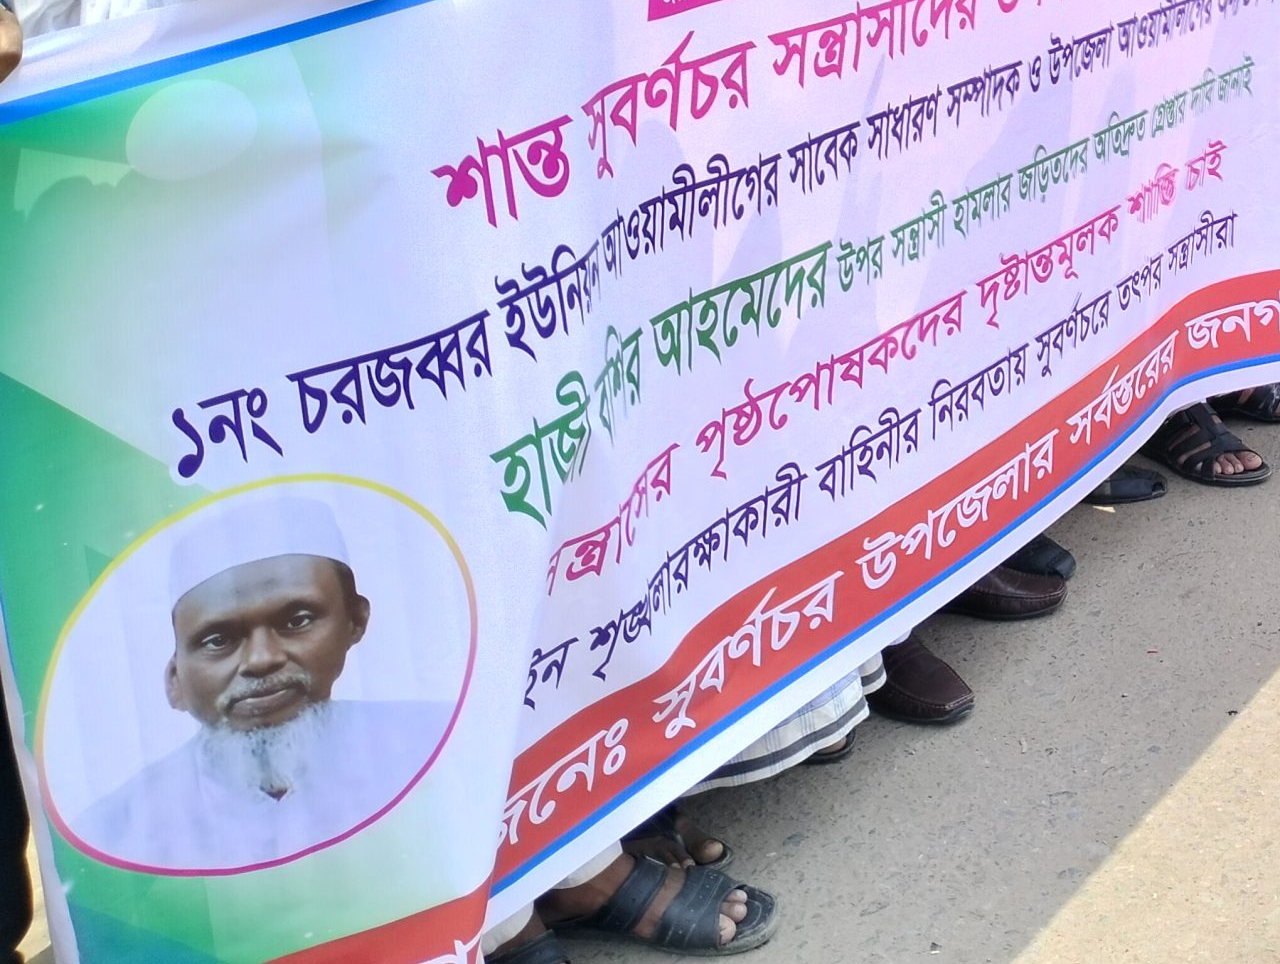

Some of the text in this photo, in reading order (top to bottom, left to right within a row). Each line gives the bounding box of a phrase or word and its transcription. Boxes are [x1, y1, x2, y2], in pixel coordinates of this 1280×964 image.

[172, 387, 283, 478] ১নং
[286, 310, 492, 434] চরজব্বর
[495, 244, 602, 363] ইউনিয়ন
[602, 153, 782, 276] আওয়ামীলীগের
[787, 121, 861, 194] সাবেক
[866, 85, 942, 161] সাধারণ
[947, 61, 1022, 127] সম্পাদক
[1029, 56, 1041, 92] ও
[1048, 21, 1114, 84] উপজেলা
[430, 115, 573, 227] শান্ত
[581, 31, 756, 179] সুবর্ণচর
[490, 371, 591, 531] হাজী
[650, 241, 833, 376] আহমেদের
[836, 235, 886, 293] উপর
[890, 189, 948, 267] সন্ত্রাসী
[952, 173, 1014, 238] হামলার
[1017, 138, 1090, 203] জড়িতদের
[1092, 111, 1149, 165] অতিদ্রুত
[1217, 52, 1255, 98] জানাই
[696, 291, 967, 479] পৃষ্ঠপোষকদের
[976, 205, 1121, 328] দৃষ্টান্তমূলক
[1126, 163, 1179, 223] শাস্তি
[1185, 139, 1227, 192] চাই
[652, 571, 844, 740] সুবর্ণচর
[855, 429, 1059, 589] উপজেলার
[1068, 330, 1180, 446] সর্বস্তরের
[815, 407, 921, 502] বাহিনীর
[928, 343, 1029, 440] নিরবতায়
[1035, 292, 1112, 377] সুবর্ণচরে
[1117, 253, 1163, 305] তৎপর
[1167, 209, 1237, 277] সন্ত্রাসীরা
